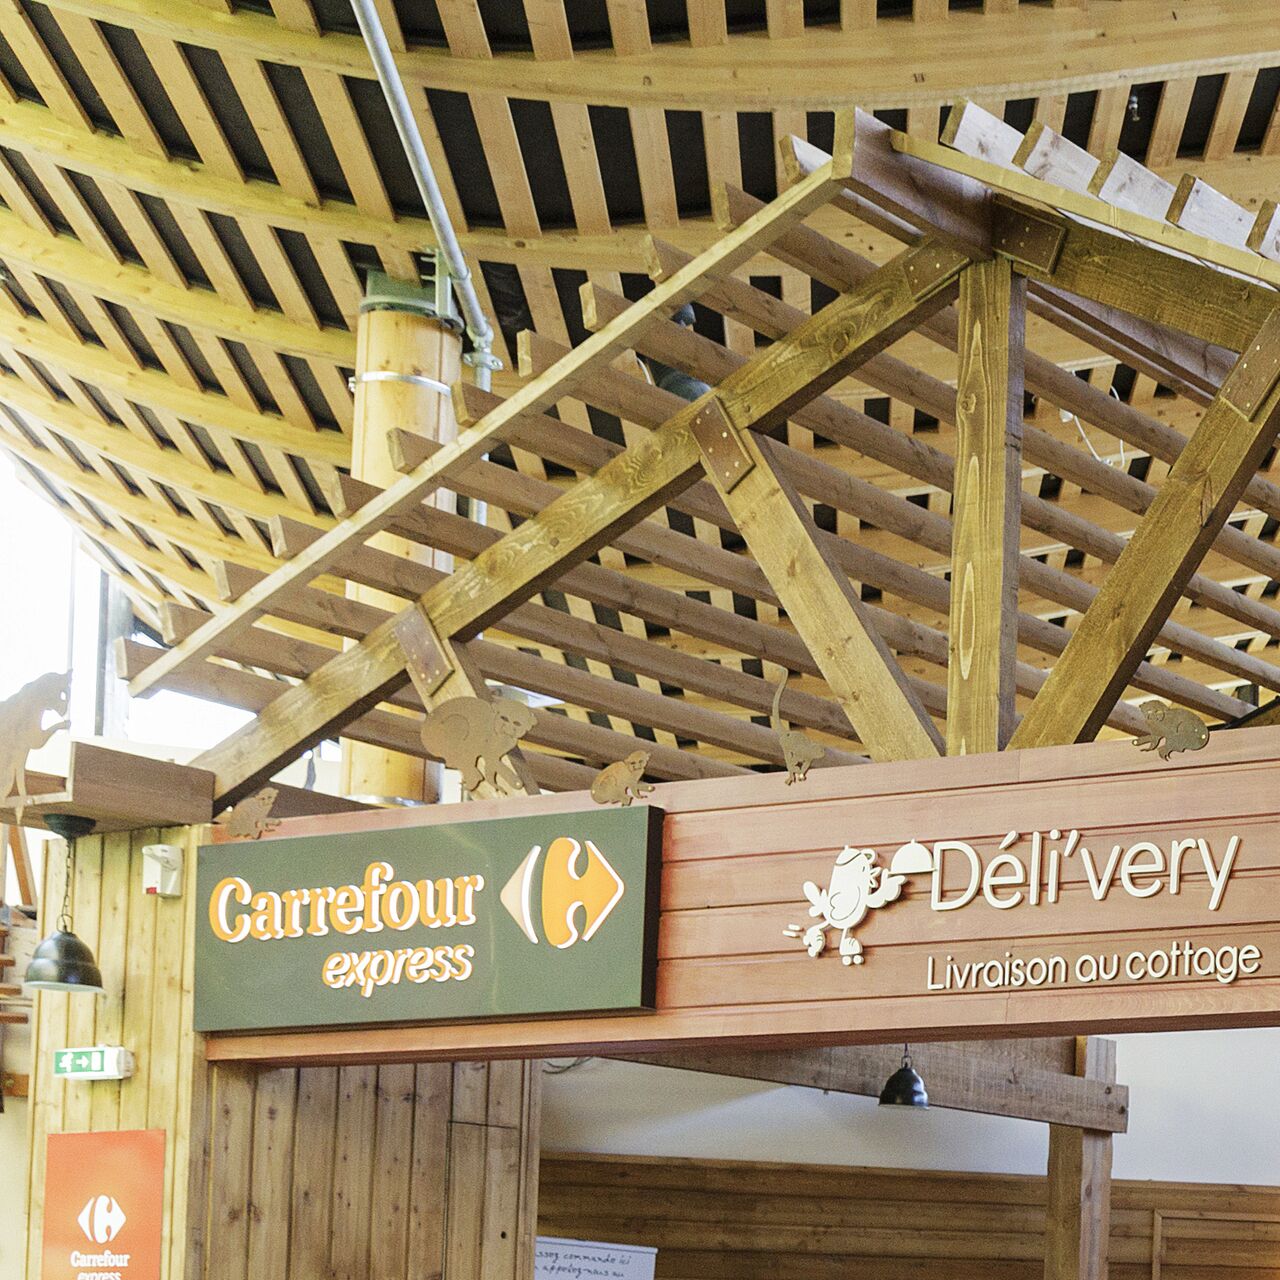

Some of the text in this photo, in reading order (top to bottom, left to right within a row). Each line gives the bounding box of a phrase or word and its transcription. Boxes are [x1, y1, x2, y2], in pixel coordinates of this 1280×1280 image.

[930, 829, 1240, 912] Déli'very
[209, 861, 485, 944] Carrefour
[322, 942, 476, 998] express
[927, 939, 1262, 991] Livraison au cottage
[71, 1250, 130, 1267] Carrefour
